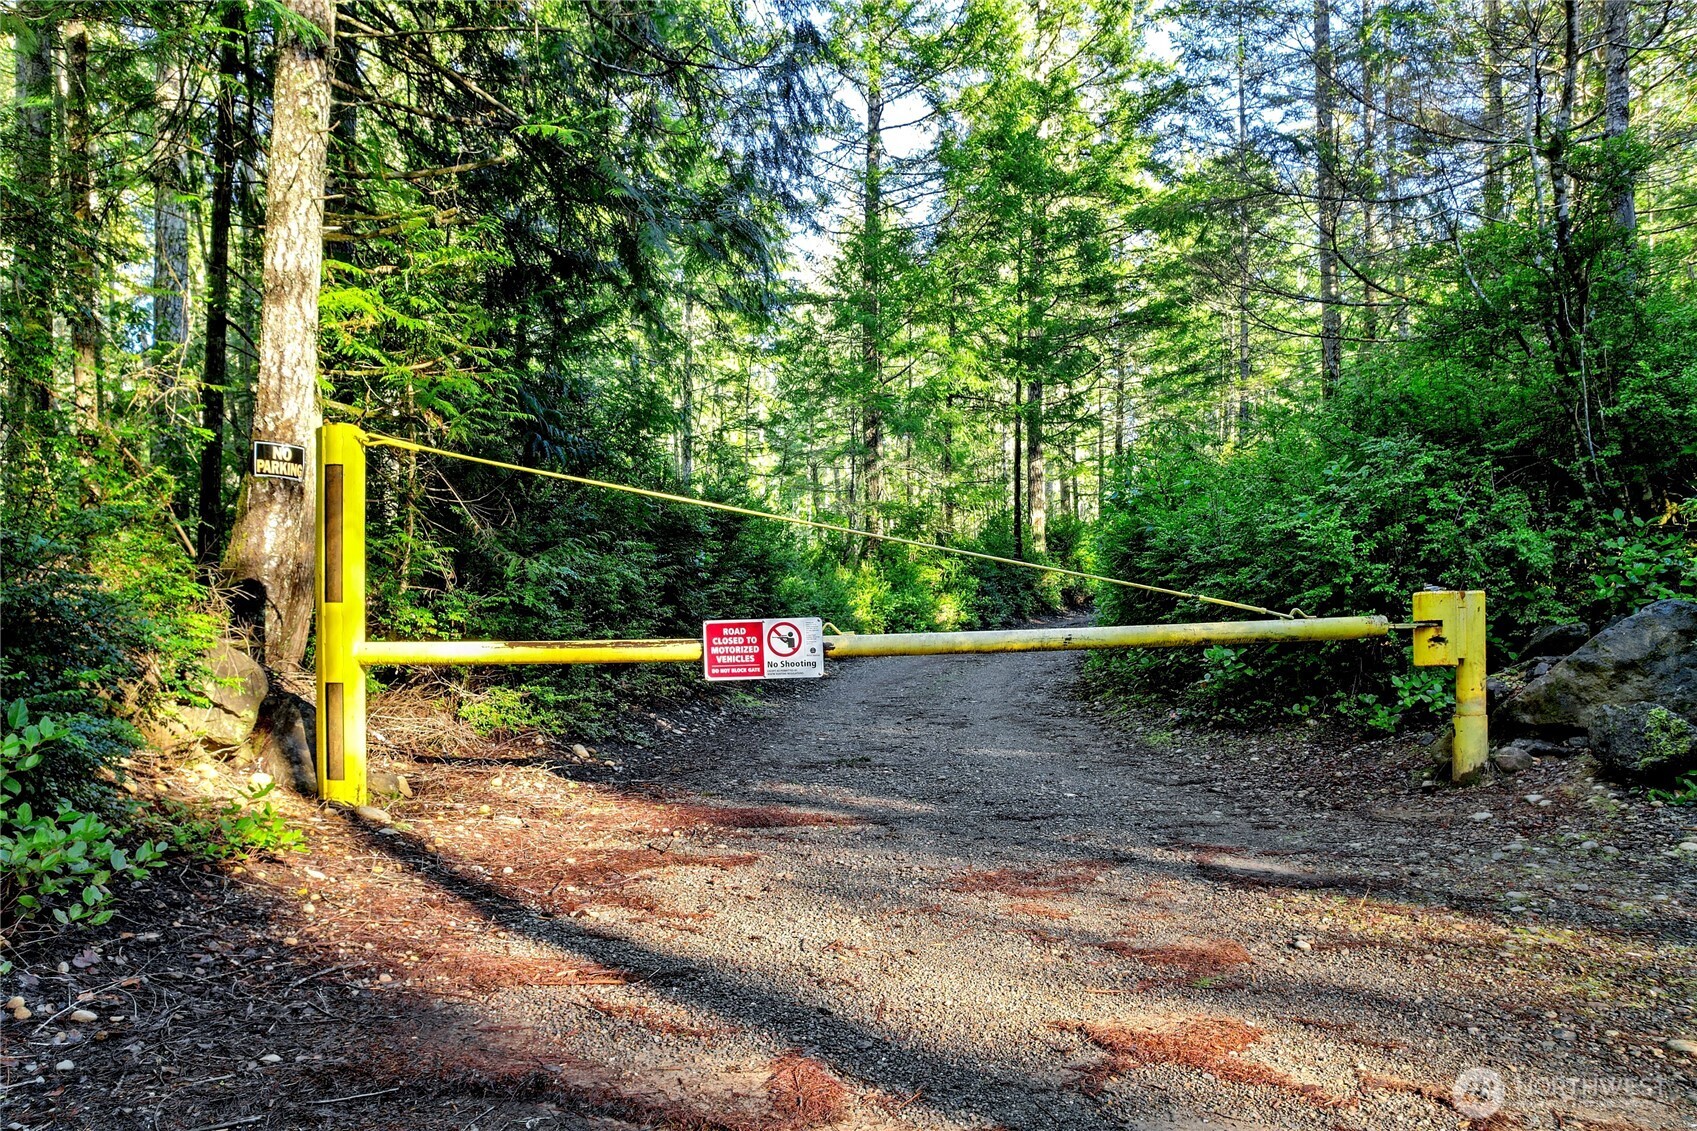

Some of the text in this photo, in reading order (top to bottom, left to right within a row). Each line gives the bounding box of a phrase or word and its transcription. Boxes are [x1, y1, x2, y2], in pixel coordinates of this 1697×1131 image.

[272, 446, 292, 461] NO
[256, 459, 303, 477] PARKING
[712, 636, 757, 645] CLOSED TO
[711, 646, 760, 654] MOTORIZED
[715, 655, 755, 663] VEHICLES
[780, 660, 817, 668] Shooting
